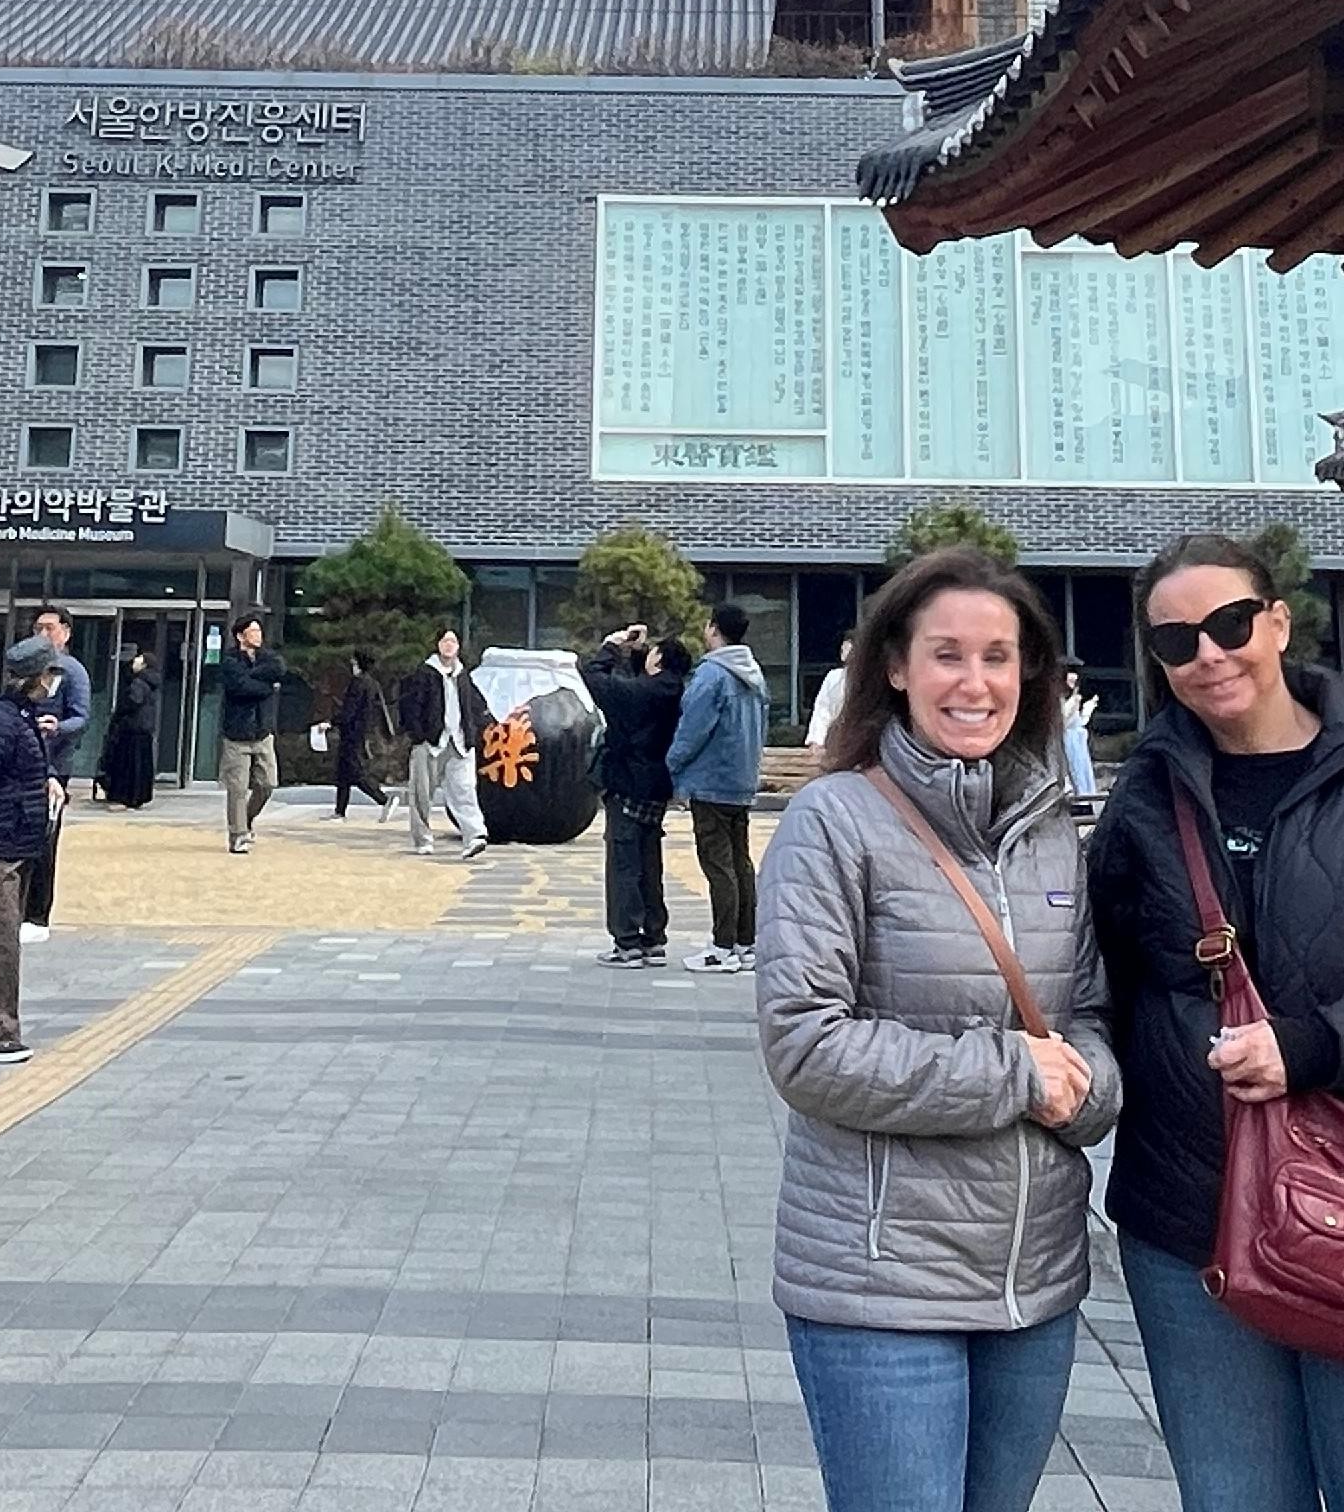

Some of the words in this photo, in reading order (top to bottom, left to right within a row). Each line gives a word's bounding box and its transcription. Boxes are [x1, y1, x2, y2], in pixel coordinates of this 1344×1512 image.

[64, 94, 367, 144] 서울한방진흥센터
[62, 151, 144, 176] Seoul
[155, 153, 254, 179] K-Medi
[265, 155, 358, 179] Center
[19, 526, 76, 541] Medicine
[78, 527, 134, 541] Museum
